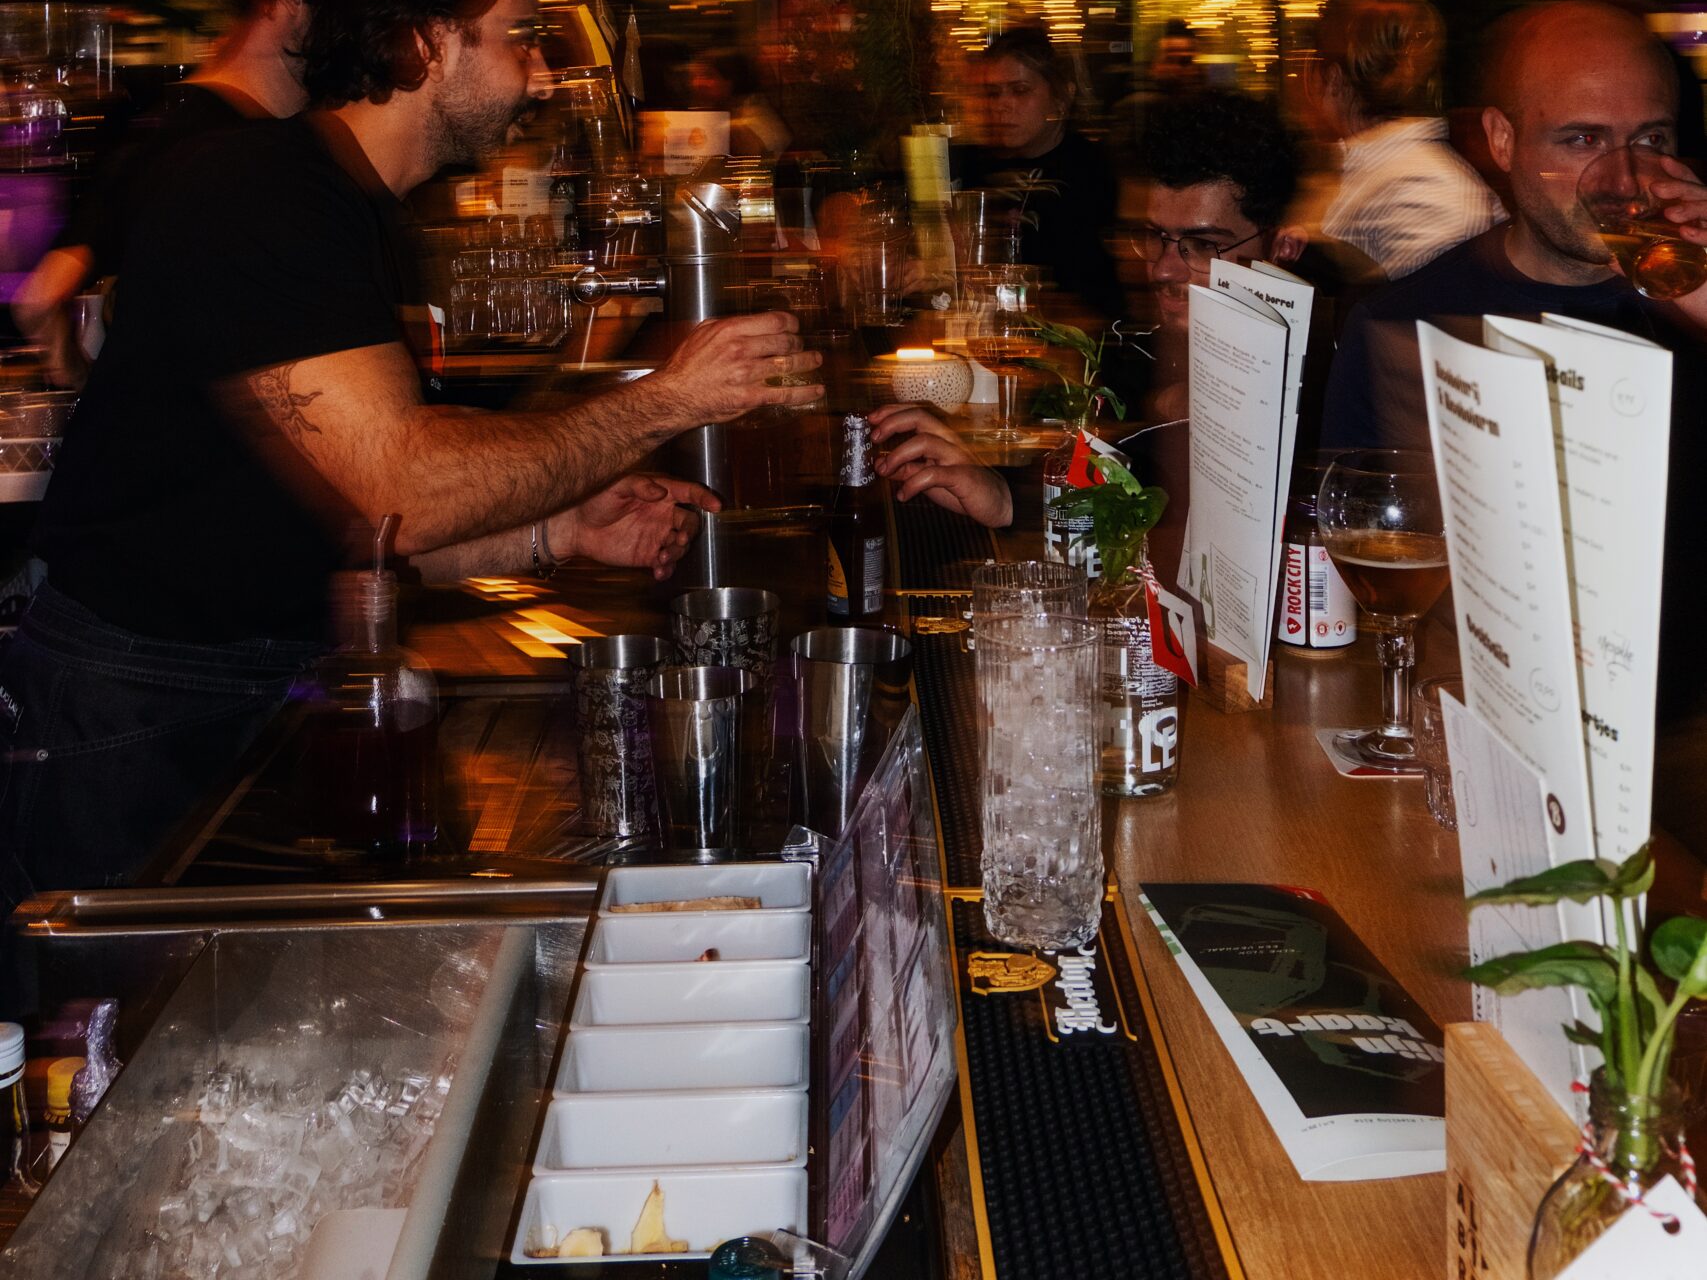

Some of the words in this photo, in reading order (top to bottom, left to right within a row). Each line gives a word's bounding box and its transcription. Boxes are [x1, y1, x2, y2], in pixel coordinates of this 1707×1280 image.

[1265, 293, 1295, 309] borrel
[1287, 546, 1302, 577] CITY
[1287, 578, 1302, 616] ROCK
[1250, 1014, 1425, 1040] kaart
